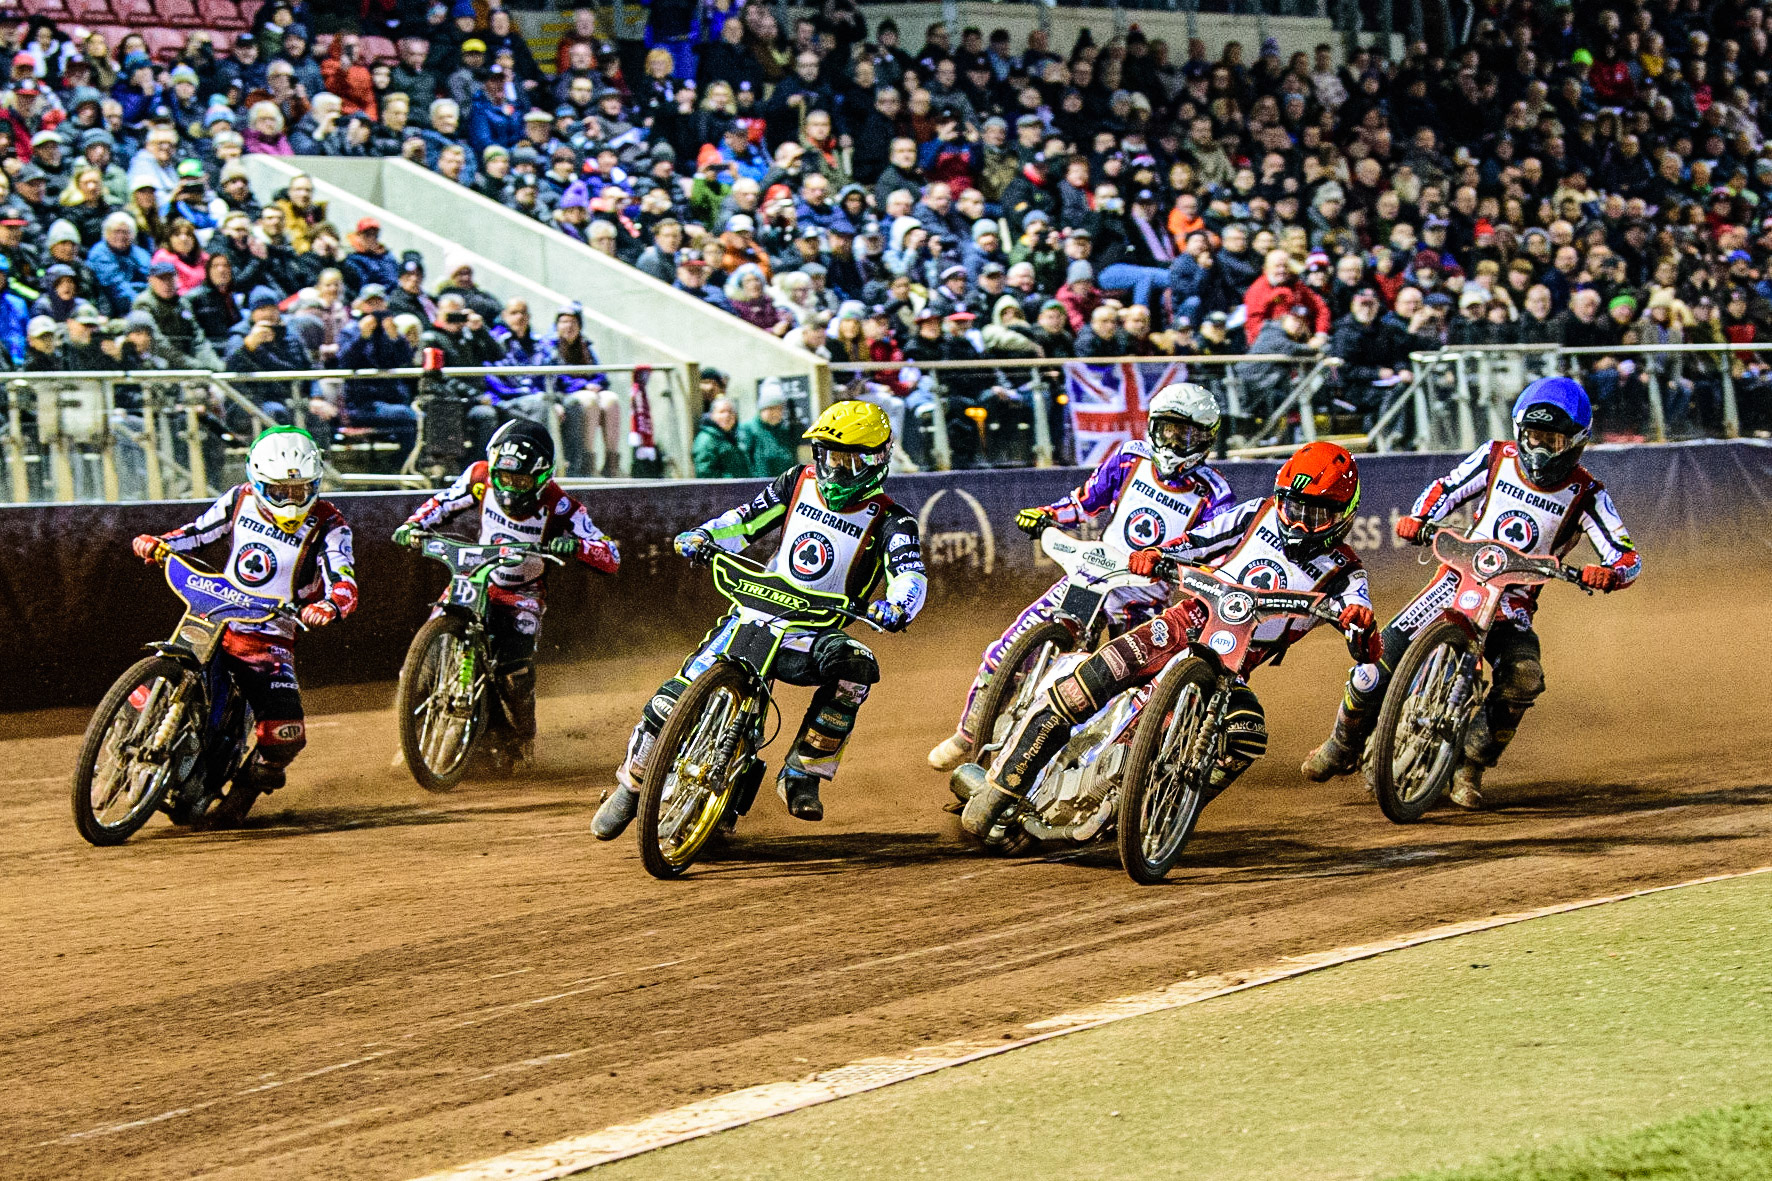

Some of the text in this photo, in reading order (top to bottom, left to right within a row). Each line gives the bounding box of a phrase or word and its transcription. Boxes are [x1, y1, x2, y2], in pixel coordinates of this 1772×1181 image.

[1131, 479, 1192, 517] PETER CRAVEN
[1193, 483, 1209, 497] 12
[1496, 480, 1566, 517] PETER CRAVEN
[1568, 483, 1581, 495] 4
[866, 502, 880, 517] 9
[1498, 510, 1516, 523] BELLE
[1517, 511, 1530, 521] VUE
[485, 507, 542, 535] PETER CRAVEN
[795, 502, 863, 539] PETER CRAVEN
[238, 515, 303, 548] PETER CRAVEN
[794, 531, 834, 561] BELLE VUE ACES
[1082, 551, 1116, 569] Crendon
[1247, 559, 1269, 570] BELLE
[1271, 561, 1283, 573] VUE
[1328, 549, 1349, 568] 16
[186, 574, 254, 607] GARCAREK
[1214, 637, 1231, 647] ATPI
[1357, 667, 1372, 686] ATPI
